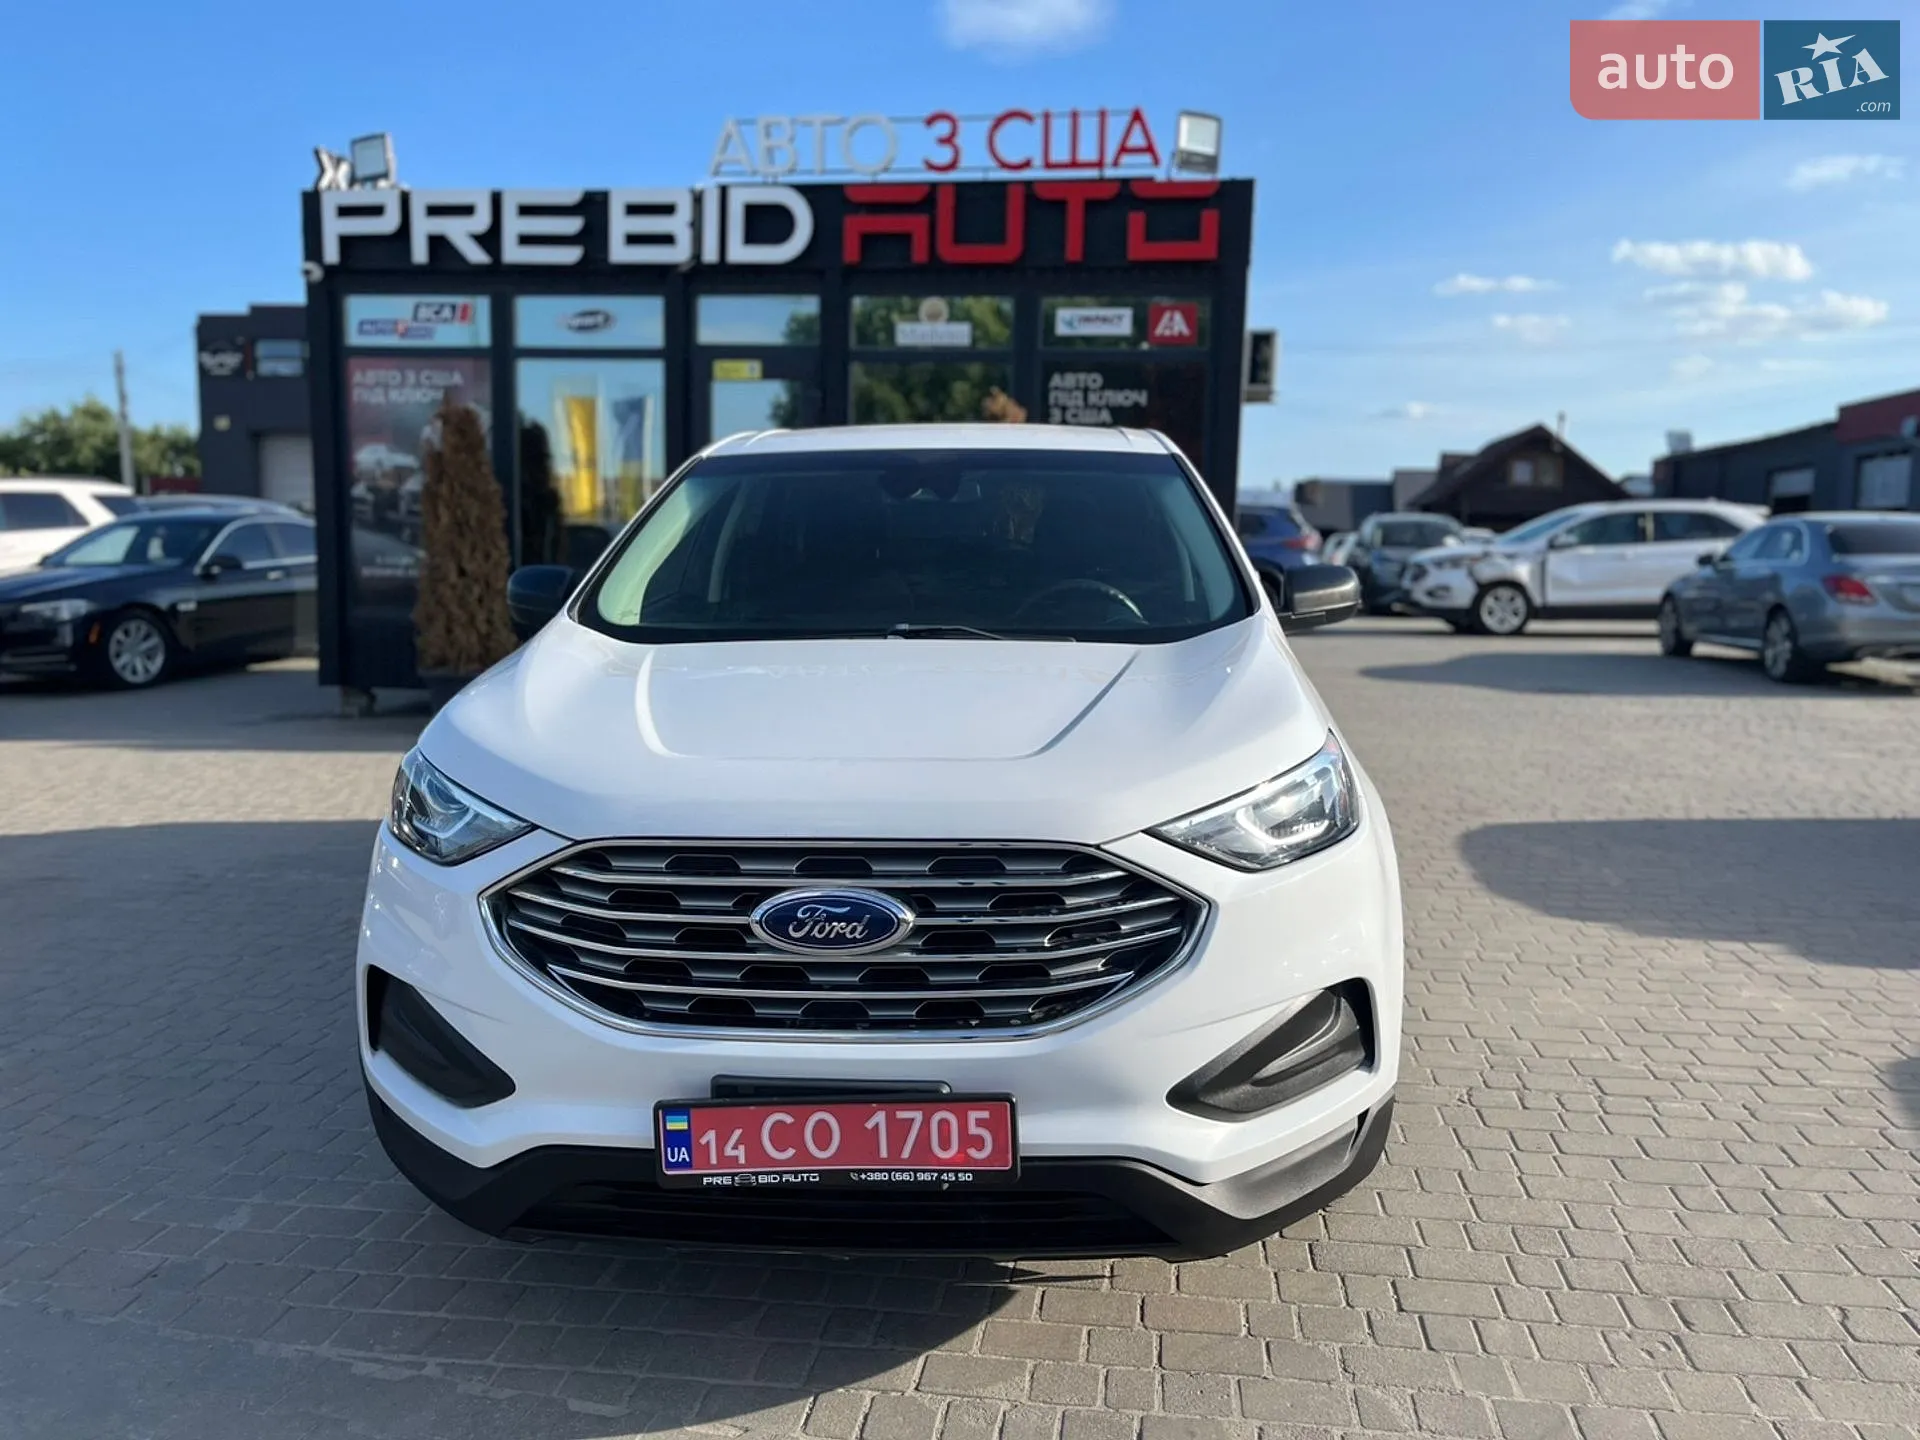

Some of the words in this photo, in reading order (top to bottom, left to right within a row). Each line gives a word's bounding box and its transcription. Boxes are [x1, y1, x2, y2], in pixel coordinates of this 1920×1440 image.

[709, 114, 898, 177] АВТО
[986, 107, 1162, 172] США
[320, 190, 585, 265] PRE
[607, 185, 815, 265] BID
[842, 181, 1221, 265] AUTO
[353, 369, 402, 387] АВТО
[420, 369, 465, 387] США
[1049, 372, 1104, 390] АВТО
[1049, 389, 1085, 408] ПІД
[1087, 389, 1148, 408] КЛЮЧ
[1064, 407, 1114, 425] США
[788, 904, 870, 939] Ford
[667, 1147, 691, 1163] UA
[699, 1128, 746, 1165] 14
[760, 1111, 842, 1160] CO
[864, 1109, 994, 1160] 1705
[703, 1176, 732, 1186] PRE
[758, 1174, 780, 1184] BID
[782, 1173, 820, 1183] AUTO
[860, 1171, 889, 1181] +380
[890, 1170, 915, 1182] (66)
[916, 1172, 938, 1181] 967
[940, 1172, 956, 1181] 45
[957, 1172, 973, 1181] 50
